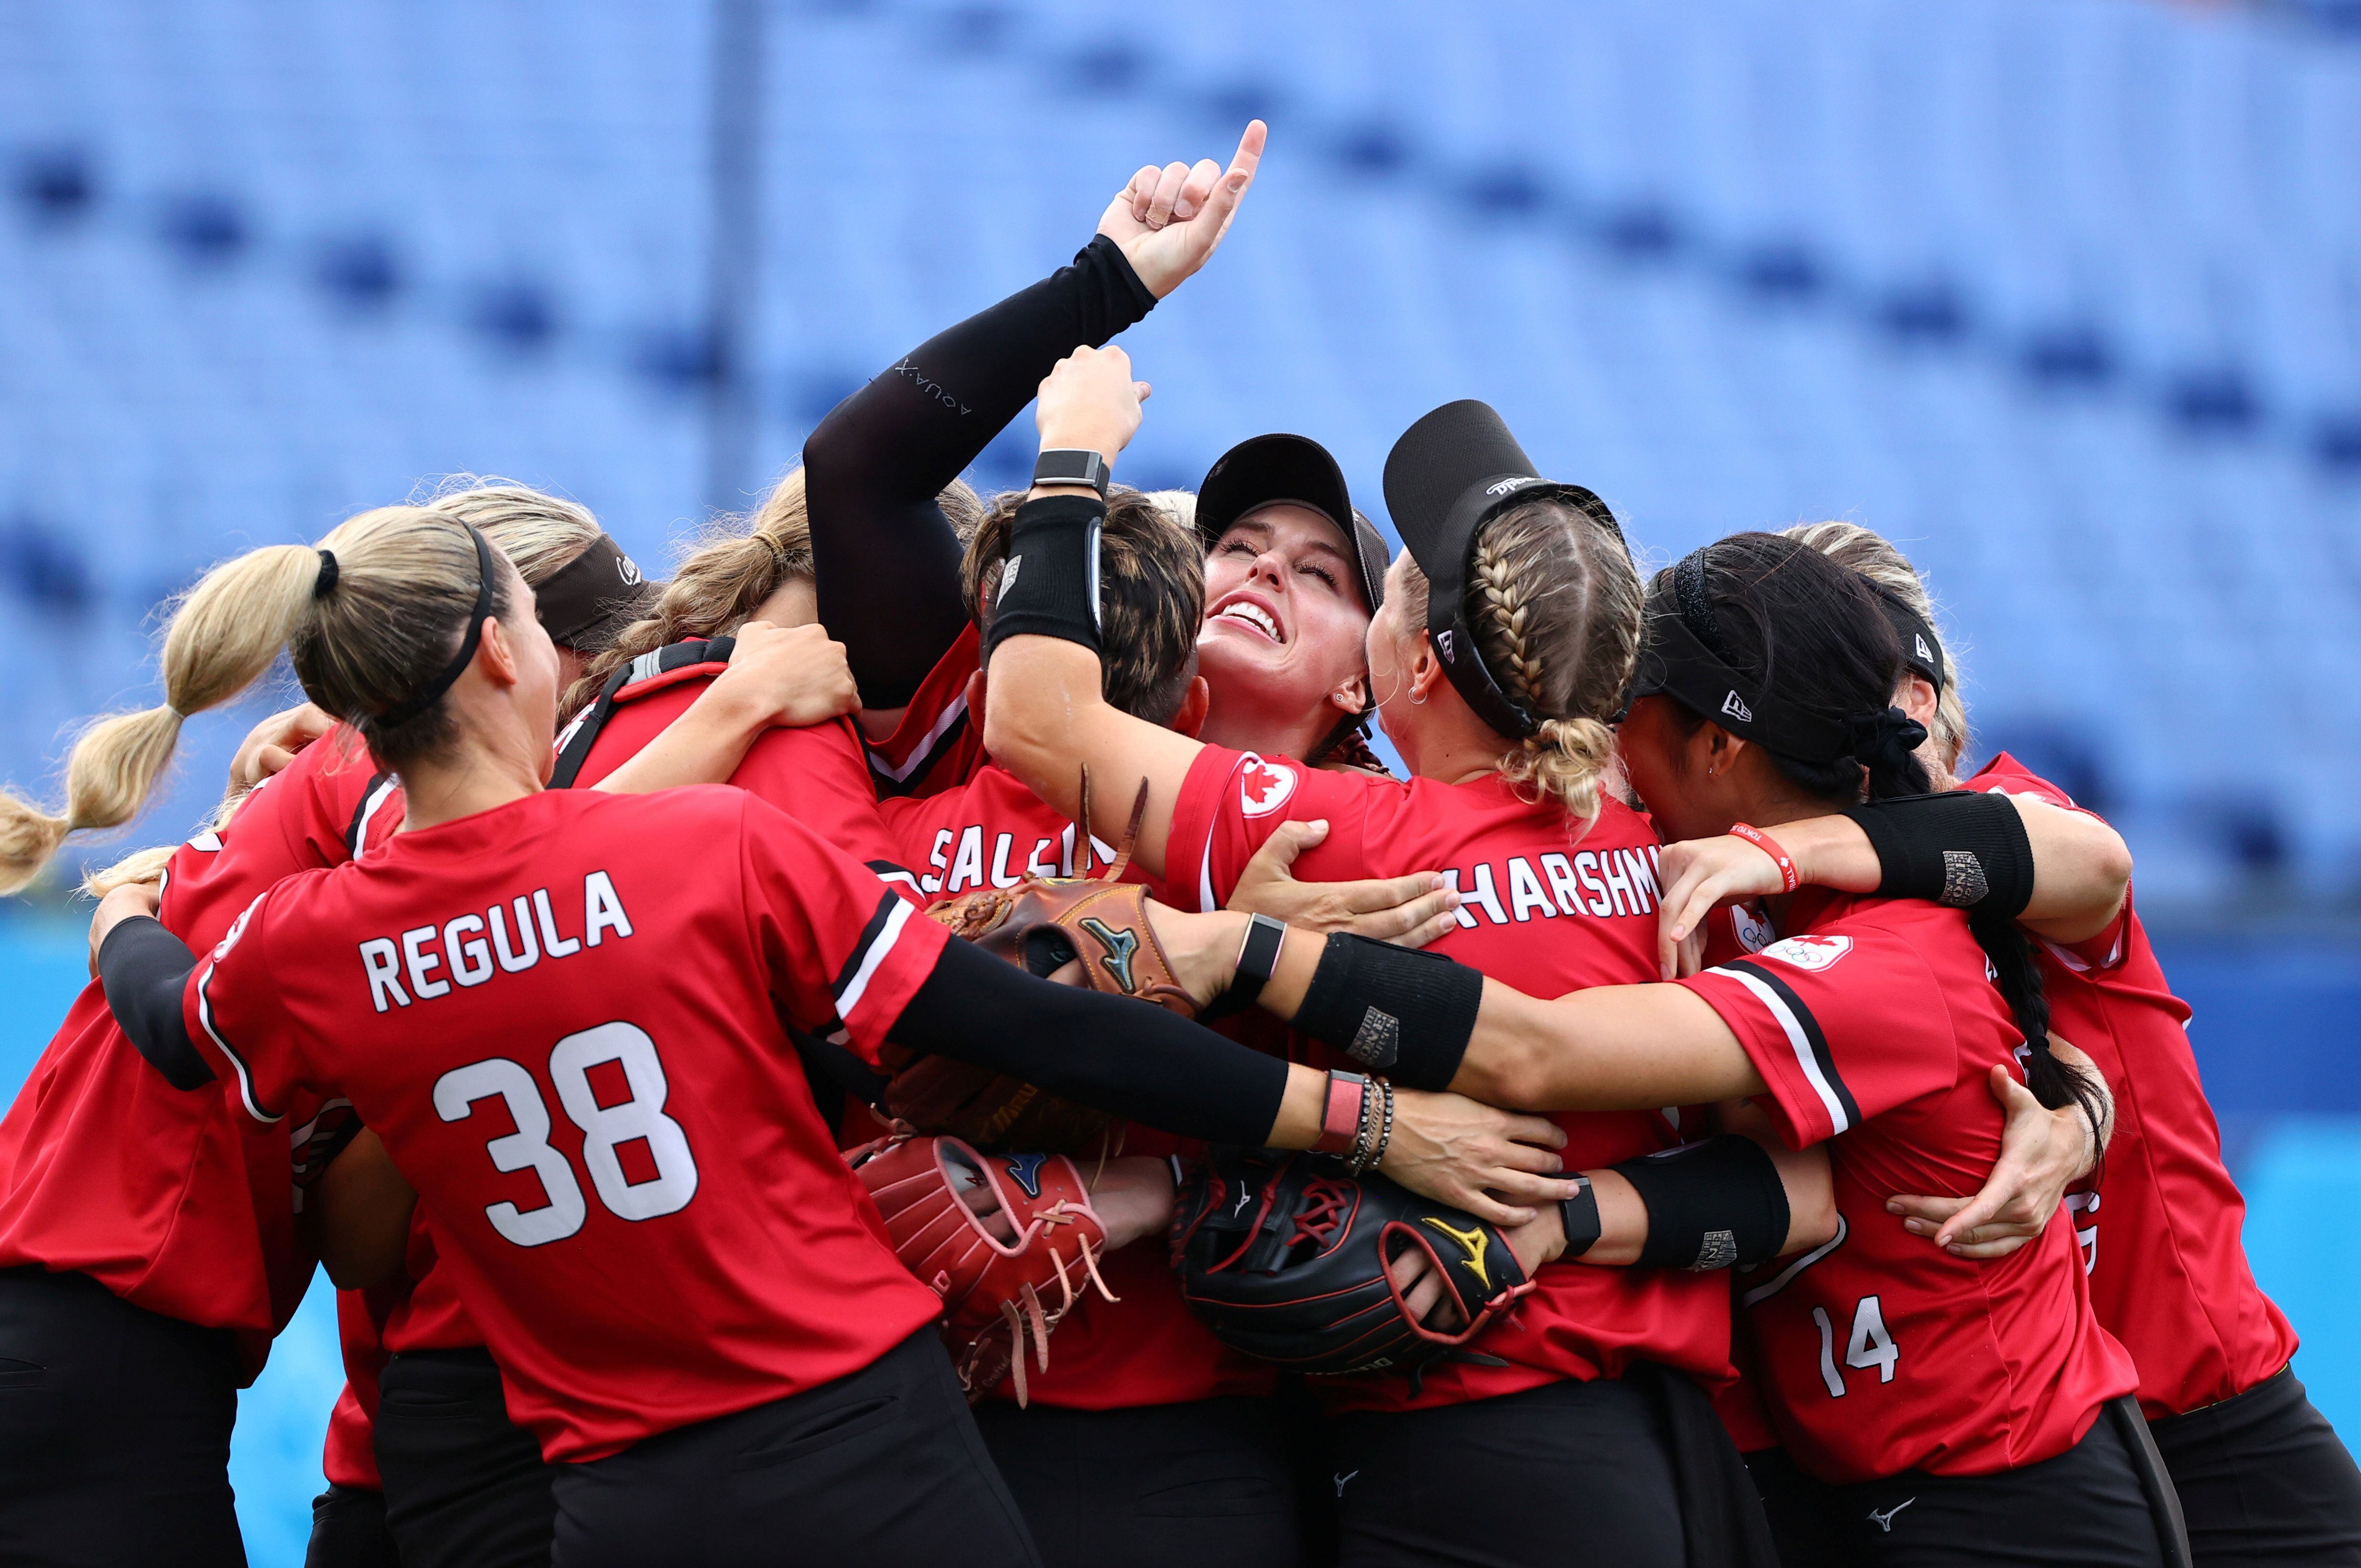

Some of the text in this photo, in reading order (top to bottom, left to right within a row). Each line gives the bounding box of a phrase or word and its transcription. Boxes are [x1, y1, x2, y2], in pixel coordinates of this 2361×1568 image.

[1737, 825, 1762, 842] TOKYO
[359, 869, 634, 1013] REGULA
[432, 1020, 699, 1248] 38
[1812, 1294, 1900, 1398] 14
